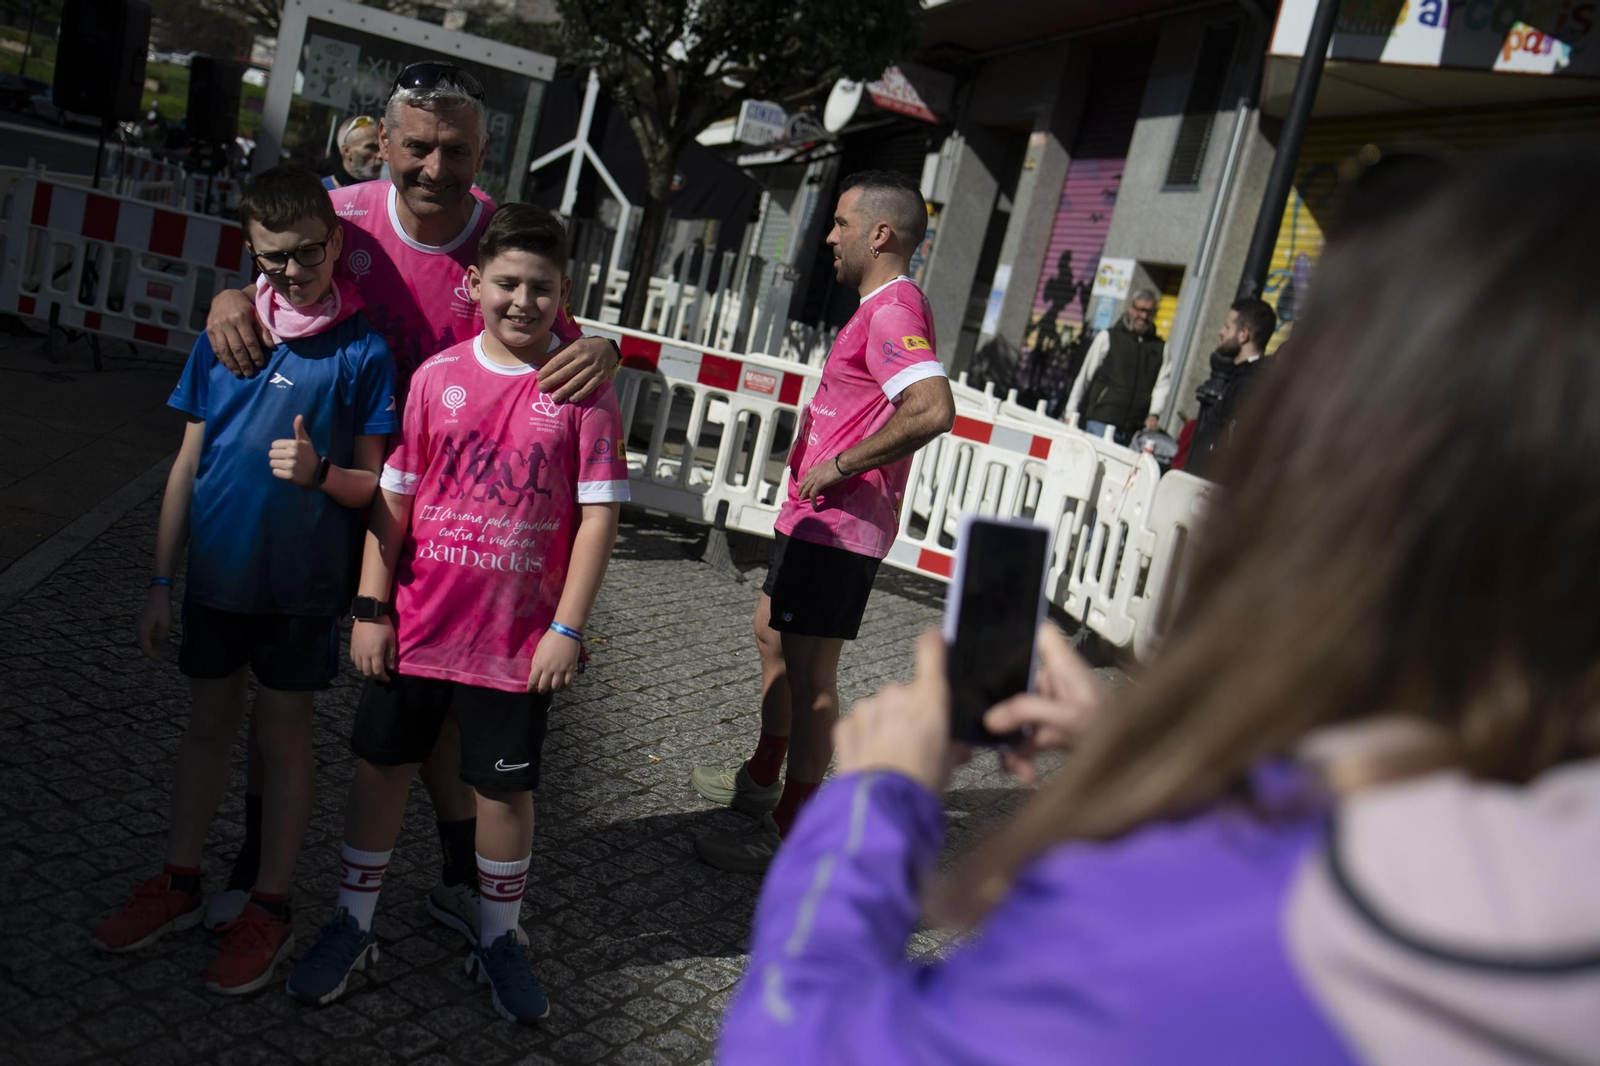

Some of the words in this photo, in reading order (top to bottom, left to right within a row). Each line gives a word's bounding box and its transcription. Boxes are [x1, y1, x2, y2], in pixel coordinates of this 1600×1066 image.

[482, 513, 511, 533] pola
[513, 517, 560, 535] igualdade
[438, 526, 474, 541] contra
[477, 535, 486, 543] a
[489, 533, 536, 548] violencia
